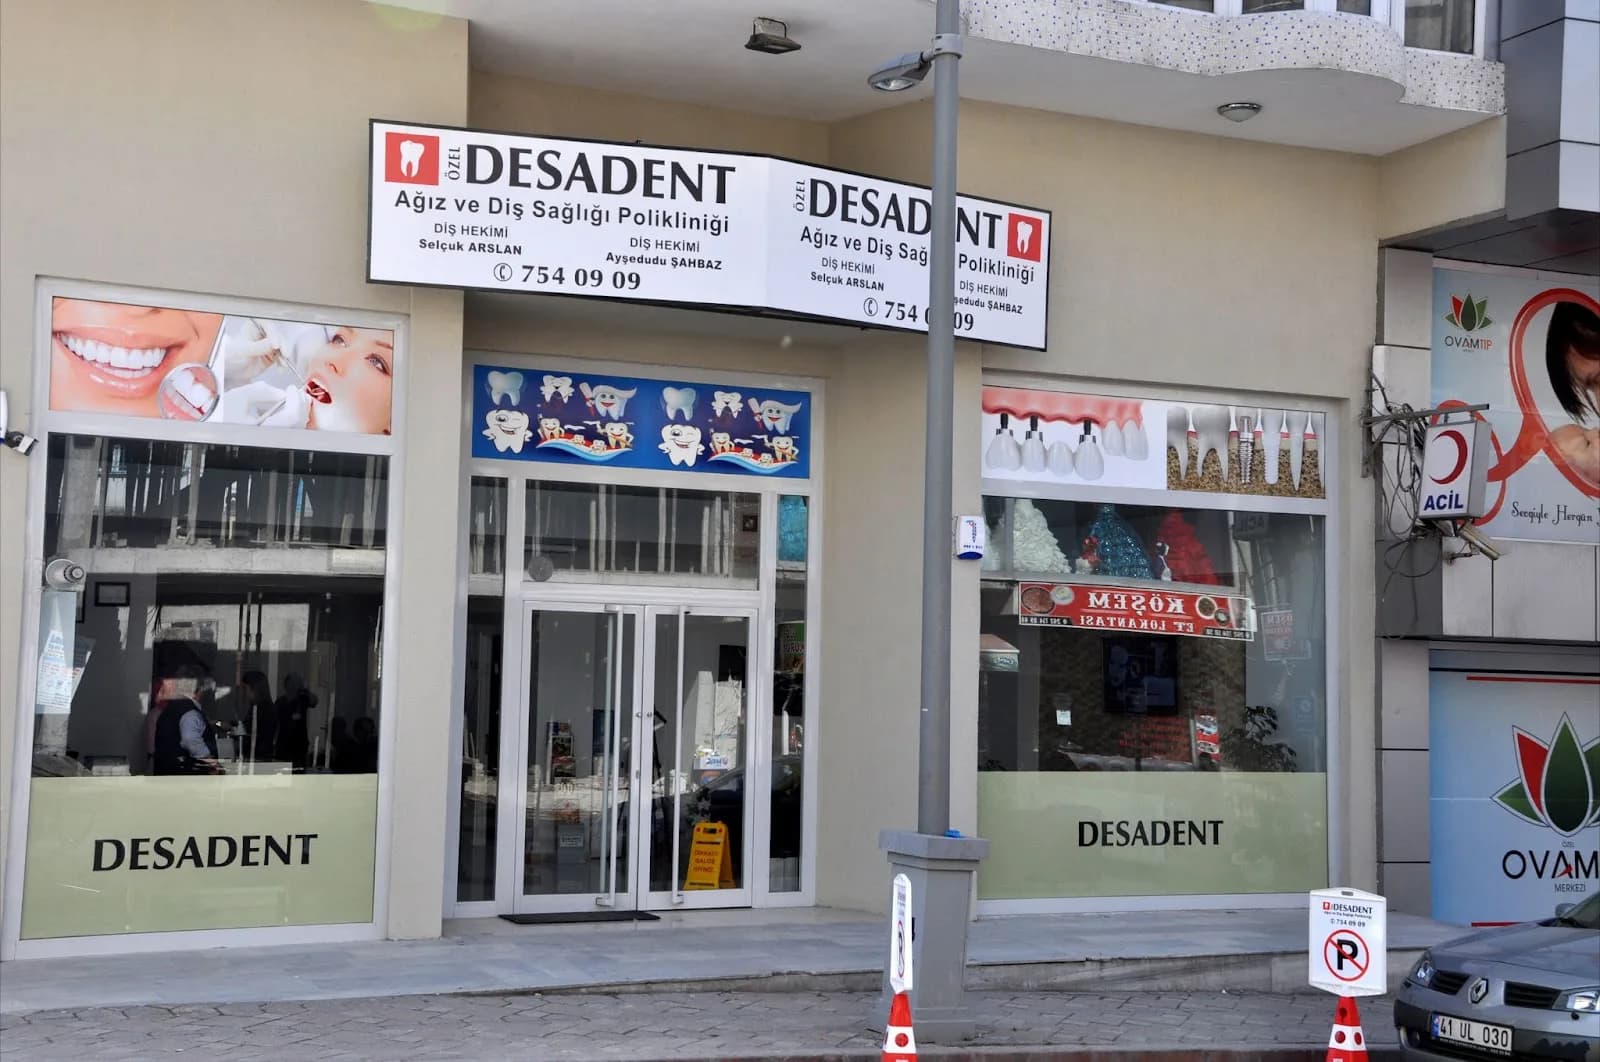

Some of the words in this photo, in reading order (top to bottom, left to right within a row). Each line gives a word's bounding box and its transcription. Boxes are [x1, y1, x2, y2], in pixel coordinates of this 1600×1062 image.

[444, 146, 461, 181] ÖZEL
[465, 143, 736, 204] DESADENT
[793, 180, 805, 212] ÖZEL
[395, 190, 447, 213] Ağız
[454, 198, 480, 214] ve
[488, 196, 524, 220] Diş
[532, 200, 610, 225] Sağlığı
[618, 207, 730, 237] Polikliniği
[809, 178, 1002, 249] DESADNT
[434, 221, 457, 237] DİŞ
[461, 223, 508, 239] HEKİMİ
[419, 238, 464, 254] Selçuk
[468, 242, 522, 256] ARSLAN
[629, 237, 651, 251] DİŞ
[655, 238, 700, 253] HEKİMİ
[800, 225, 838, 249] Ağız
[844, 236, 862, 252] ve
[868, 237, 893, 260] Diş
[958, 254, 1035, 285] Polikliniği
[606, 252, 667, 268] Ayşedudu
[671, 256, 722, 271] ŞAHBAZ
[821, 256, 838, 270] DİŞ
[841, 259, 875, 275] HEKİMİ
[522, 264, 565, 285] 754
[574, 267, 603, 288] 09
[612, 269, 641, 290] 09
[811, 271, 843, 286] Selçuk
[846, 277, 884, 292] ARSLAN
[959, 280, 975, 293] DİŞ
[977, 284, 1008, 298] HEKİMİ
[885, 301, 918, 322] 754
[954, 296, 985, 309] şedudu
[988, 299, 1023, 315] ŞAHBAZ
[1424, 490, 1464, 511] ACİL
[1078, 820, 1225, 847] DESADENT
[92, 833, 319, 872] DESADENT
[1502, 850, 1599, 880] OVAM
[1333, 903, 1373, 914] DESADENT
[1440, 1018, 1452, 1036] 41
[1460, 1023, 1474, 1041] UL
[1483, 1027, 1508, 1047] 030
